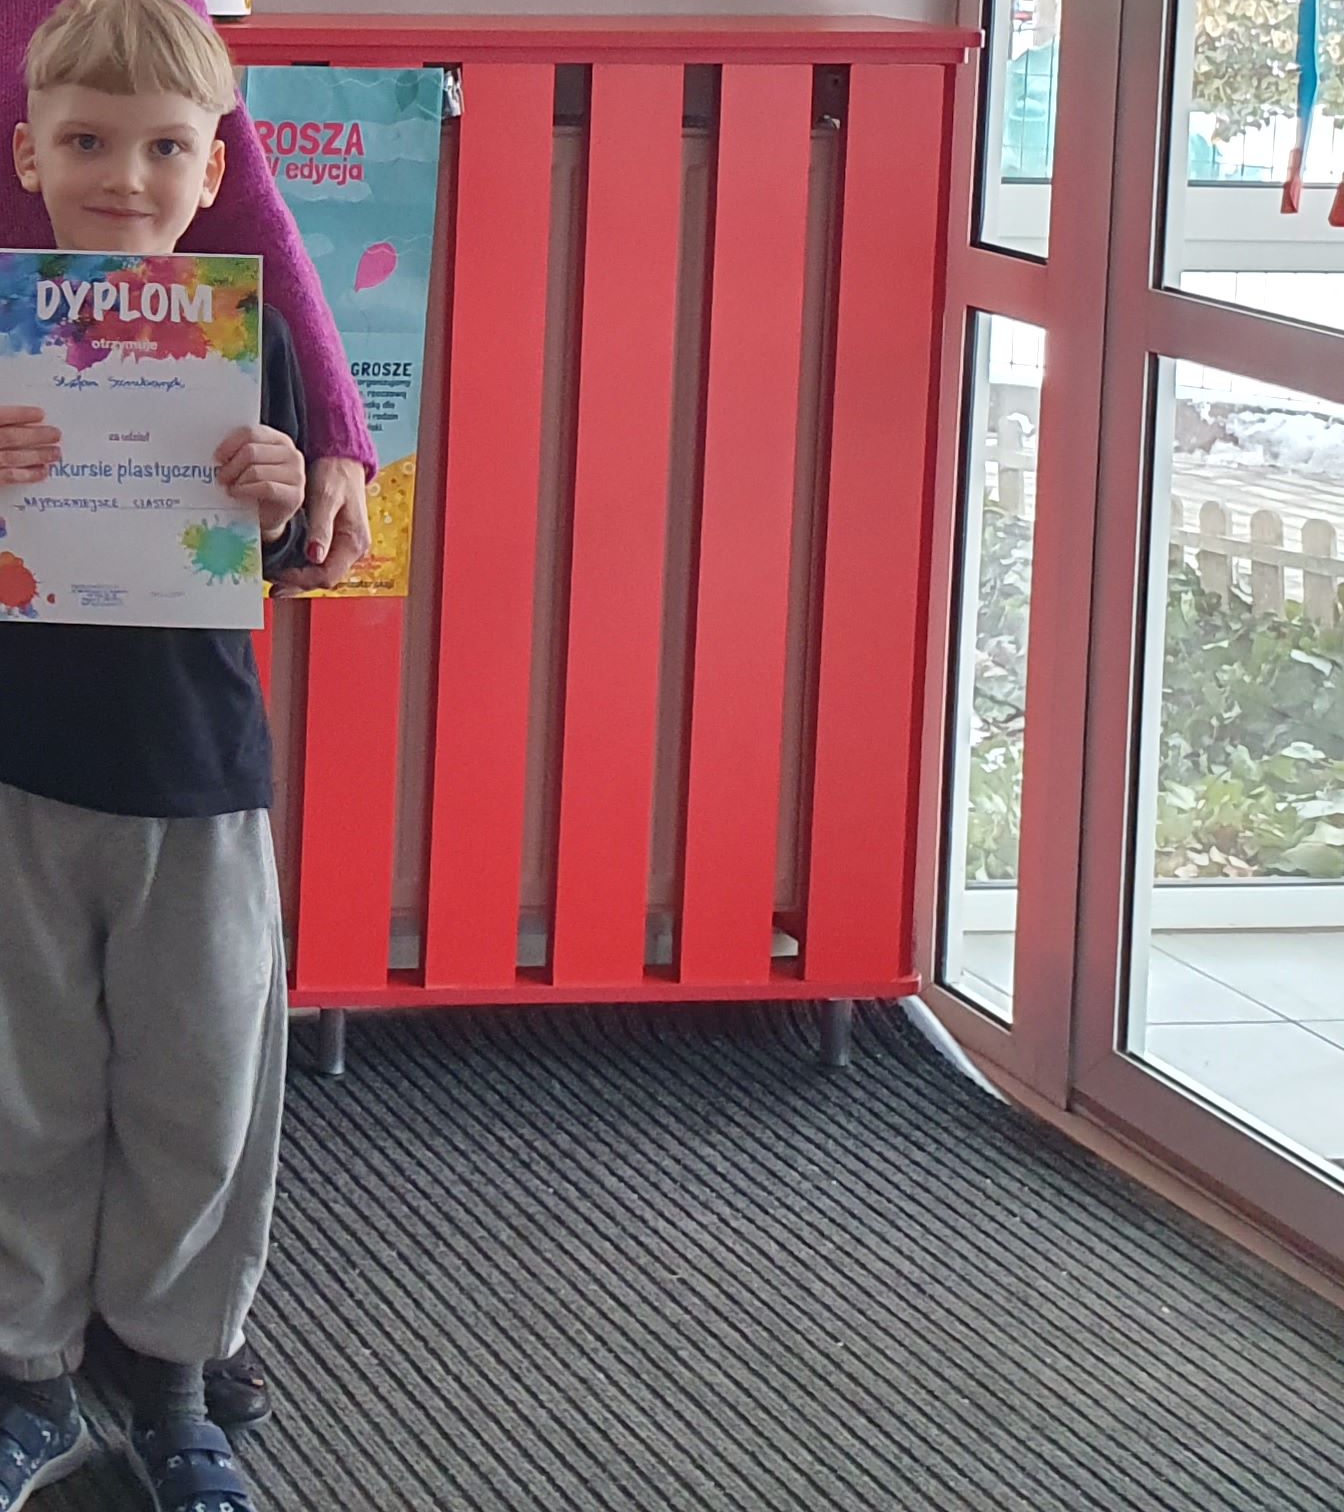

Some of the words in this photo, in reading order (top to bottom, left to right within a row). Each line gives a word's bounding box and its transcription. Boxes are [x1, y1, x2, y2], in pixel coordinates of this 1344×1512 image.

[254, 120, 364, 156] ROSZA
[285, 157, 362, 185] edycja
[36, 280, 214, 324] DYPLOM
[351, 362, 412, 377] GROSZE
[48, 461, 113, 479] nkursie
